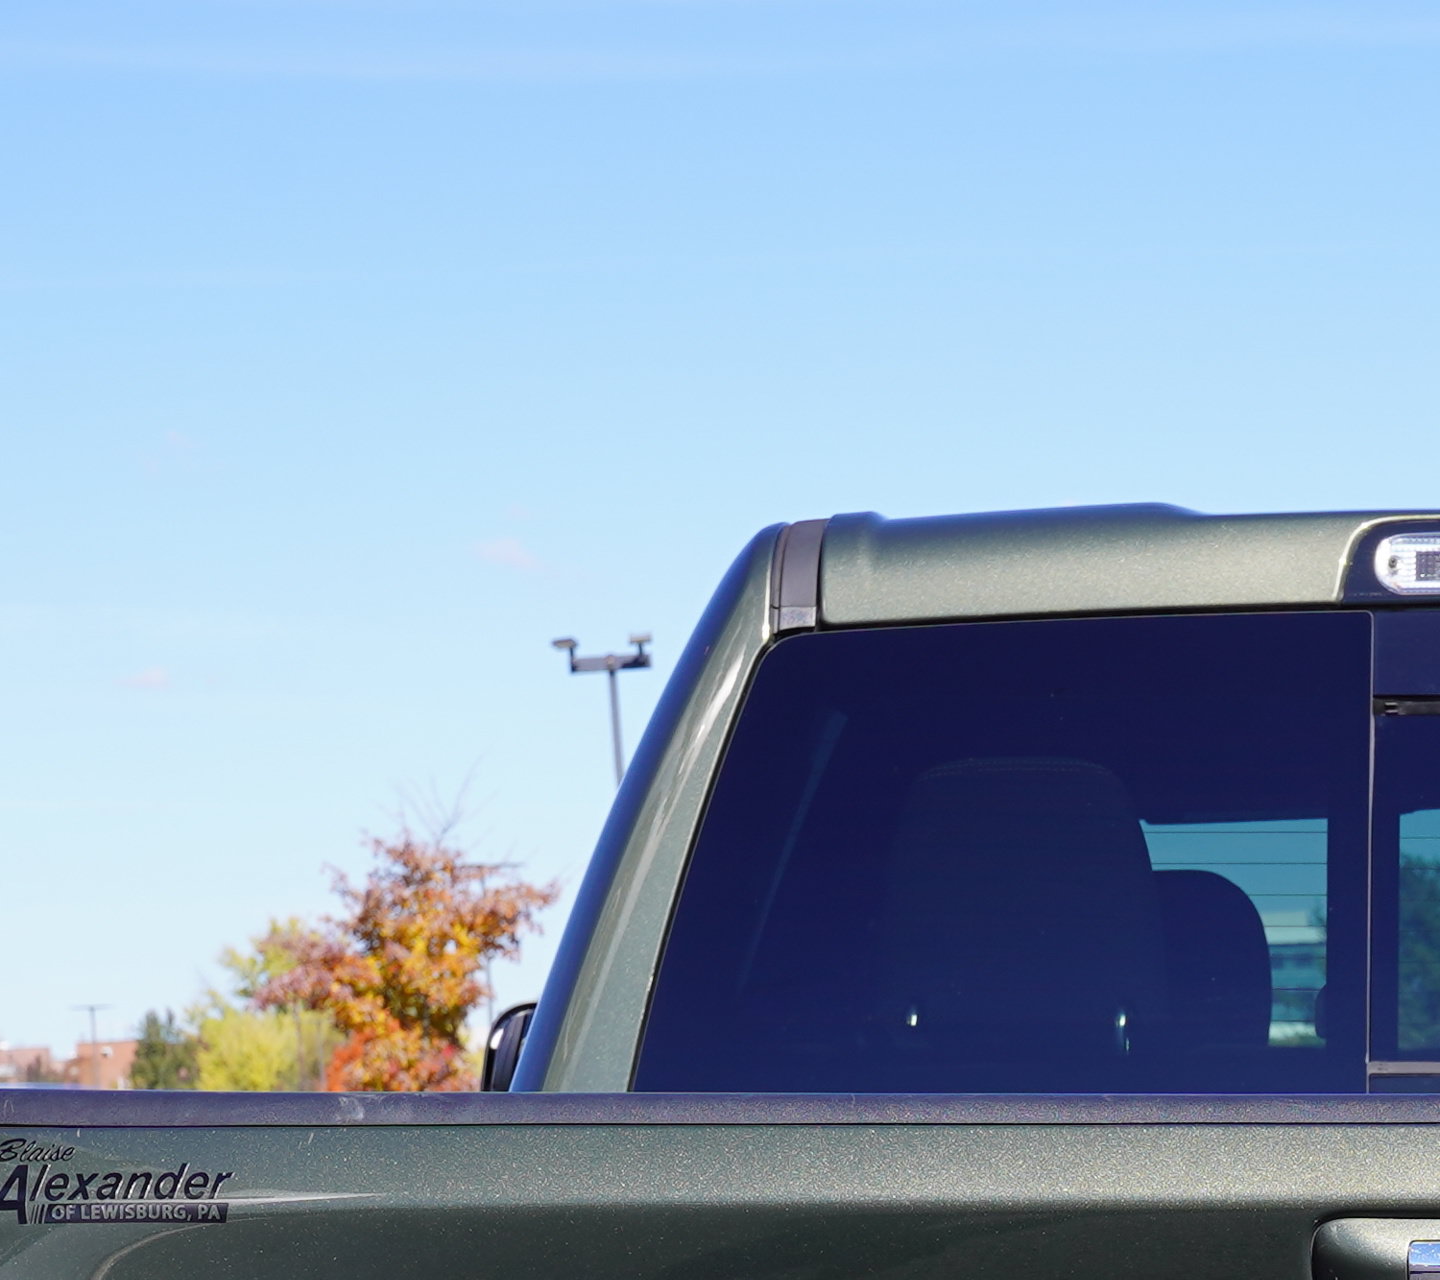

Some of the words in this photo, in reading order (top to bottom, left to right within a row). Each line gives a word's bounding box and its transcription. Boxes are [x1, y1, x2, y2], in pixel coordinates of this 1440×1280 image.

[51, 1204, 76, 1220] OF
[80, 1204, 192, 1222] LEWISBURG,
[197, 1204, 221, 1220] PA
